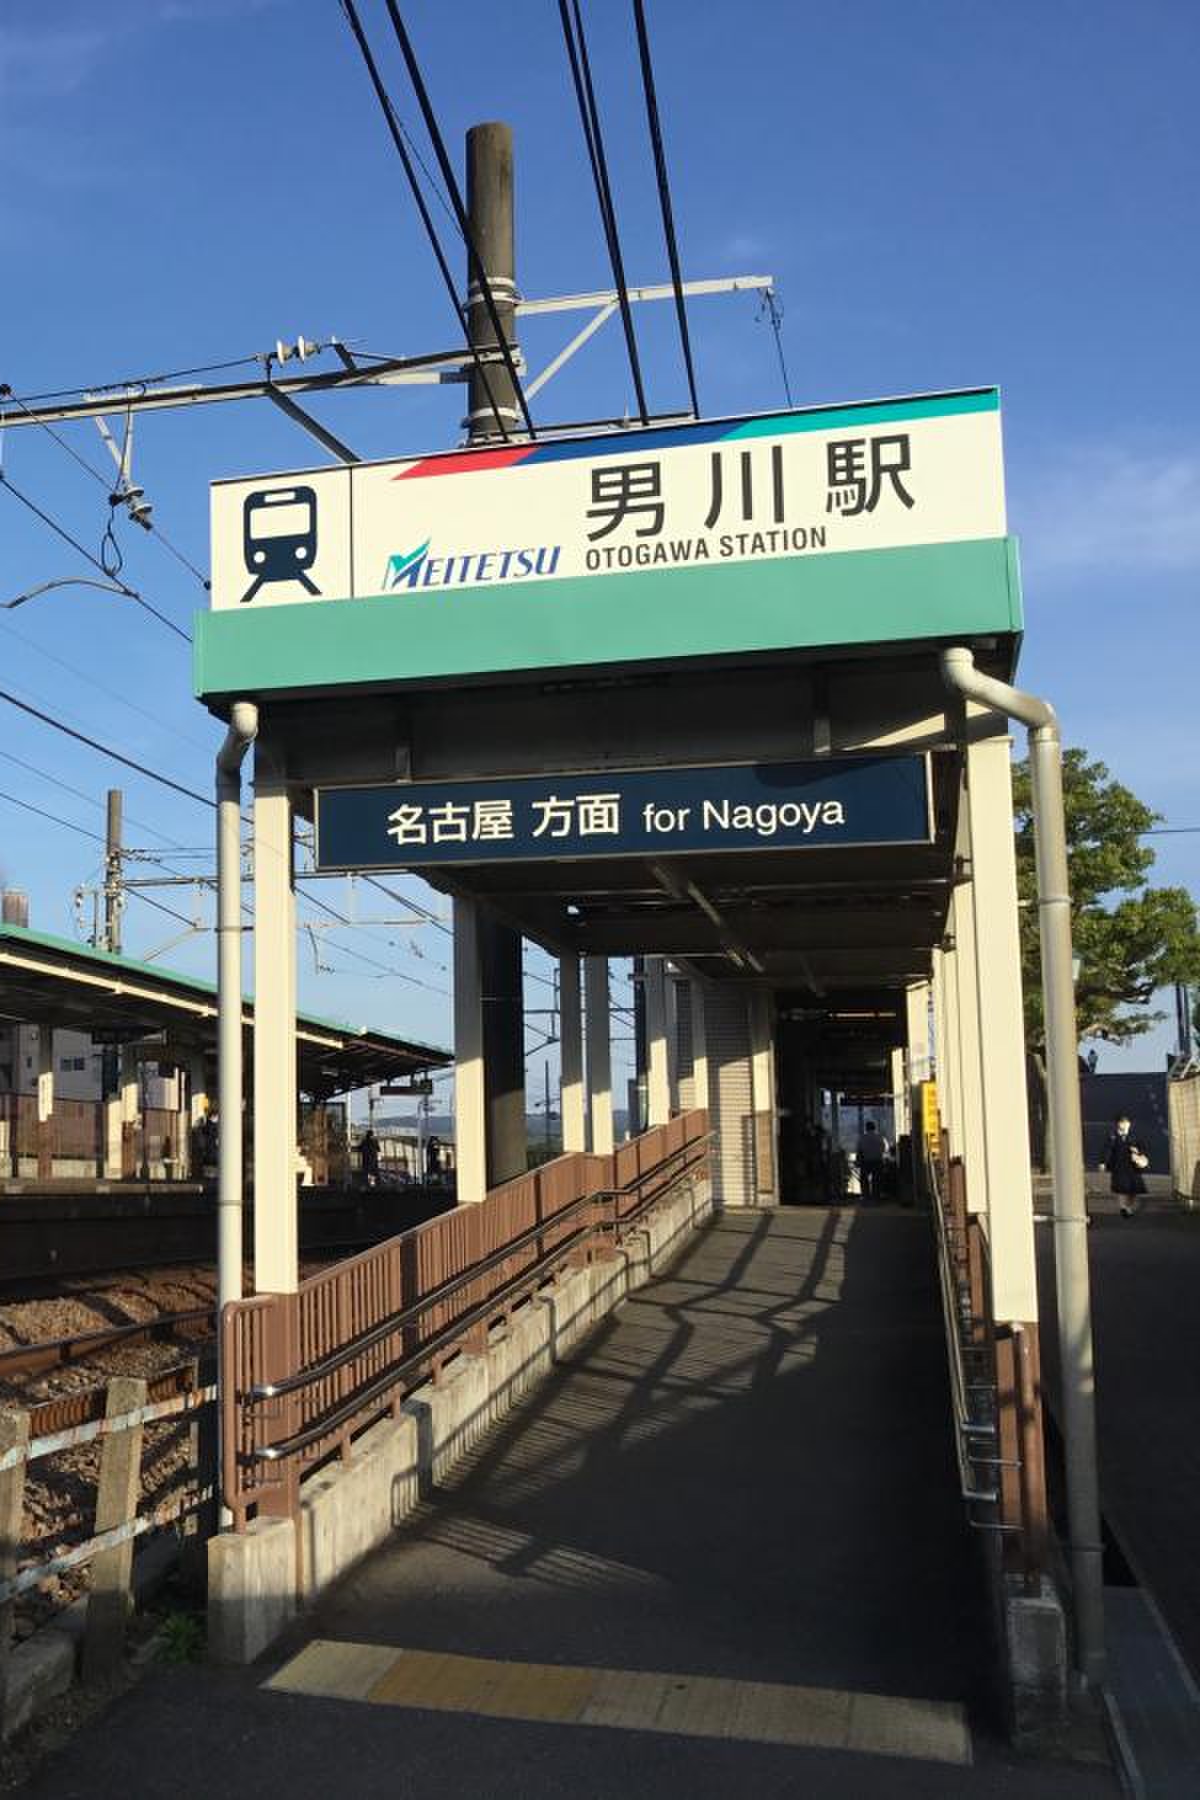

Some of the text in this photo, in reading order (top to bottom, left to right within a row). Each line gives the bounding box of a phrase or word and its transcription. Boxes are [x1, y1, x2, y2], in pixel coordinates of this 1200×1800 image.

[586, 433, 915, 542] 男川駅
[381, 537, 561, 590] MEITETSU
[586, 526, 827, 571] OTOGAWA STATION
[386, 793, 621, 845] 名古屋 方面
[642, 799, 846, 836] for Nagoya
